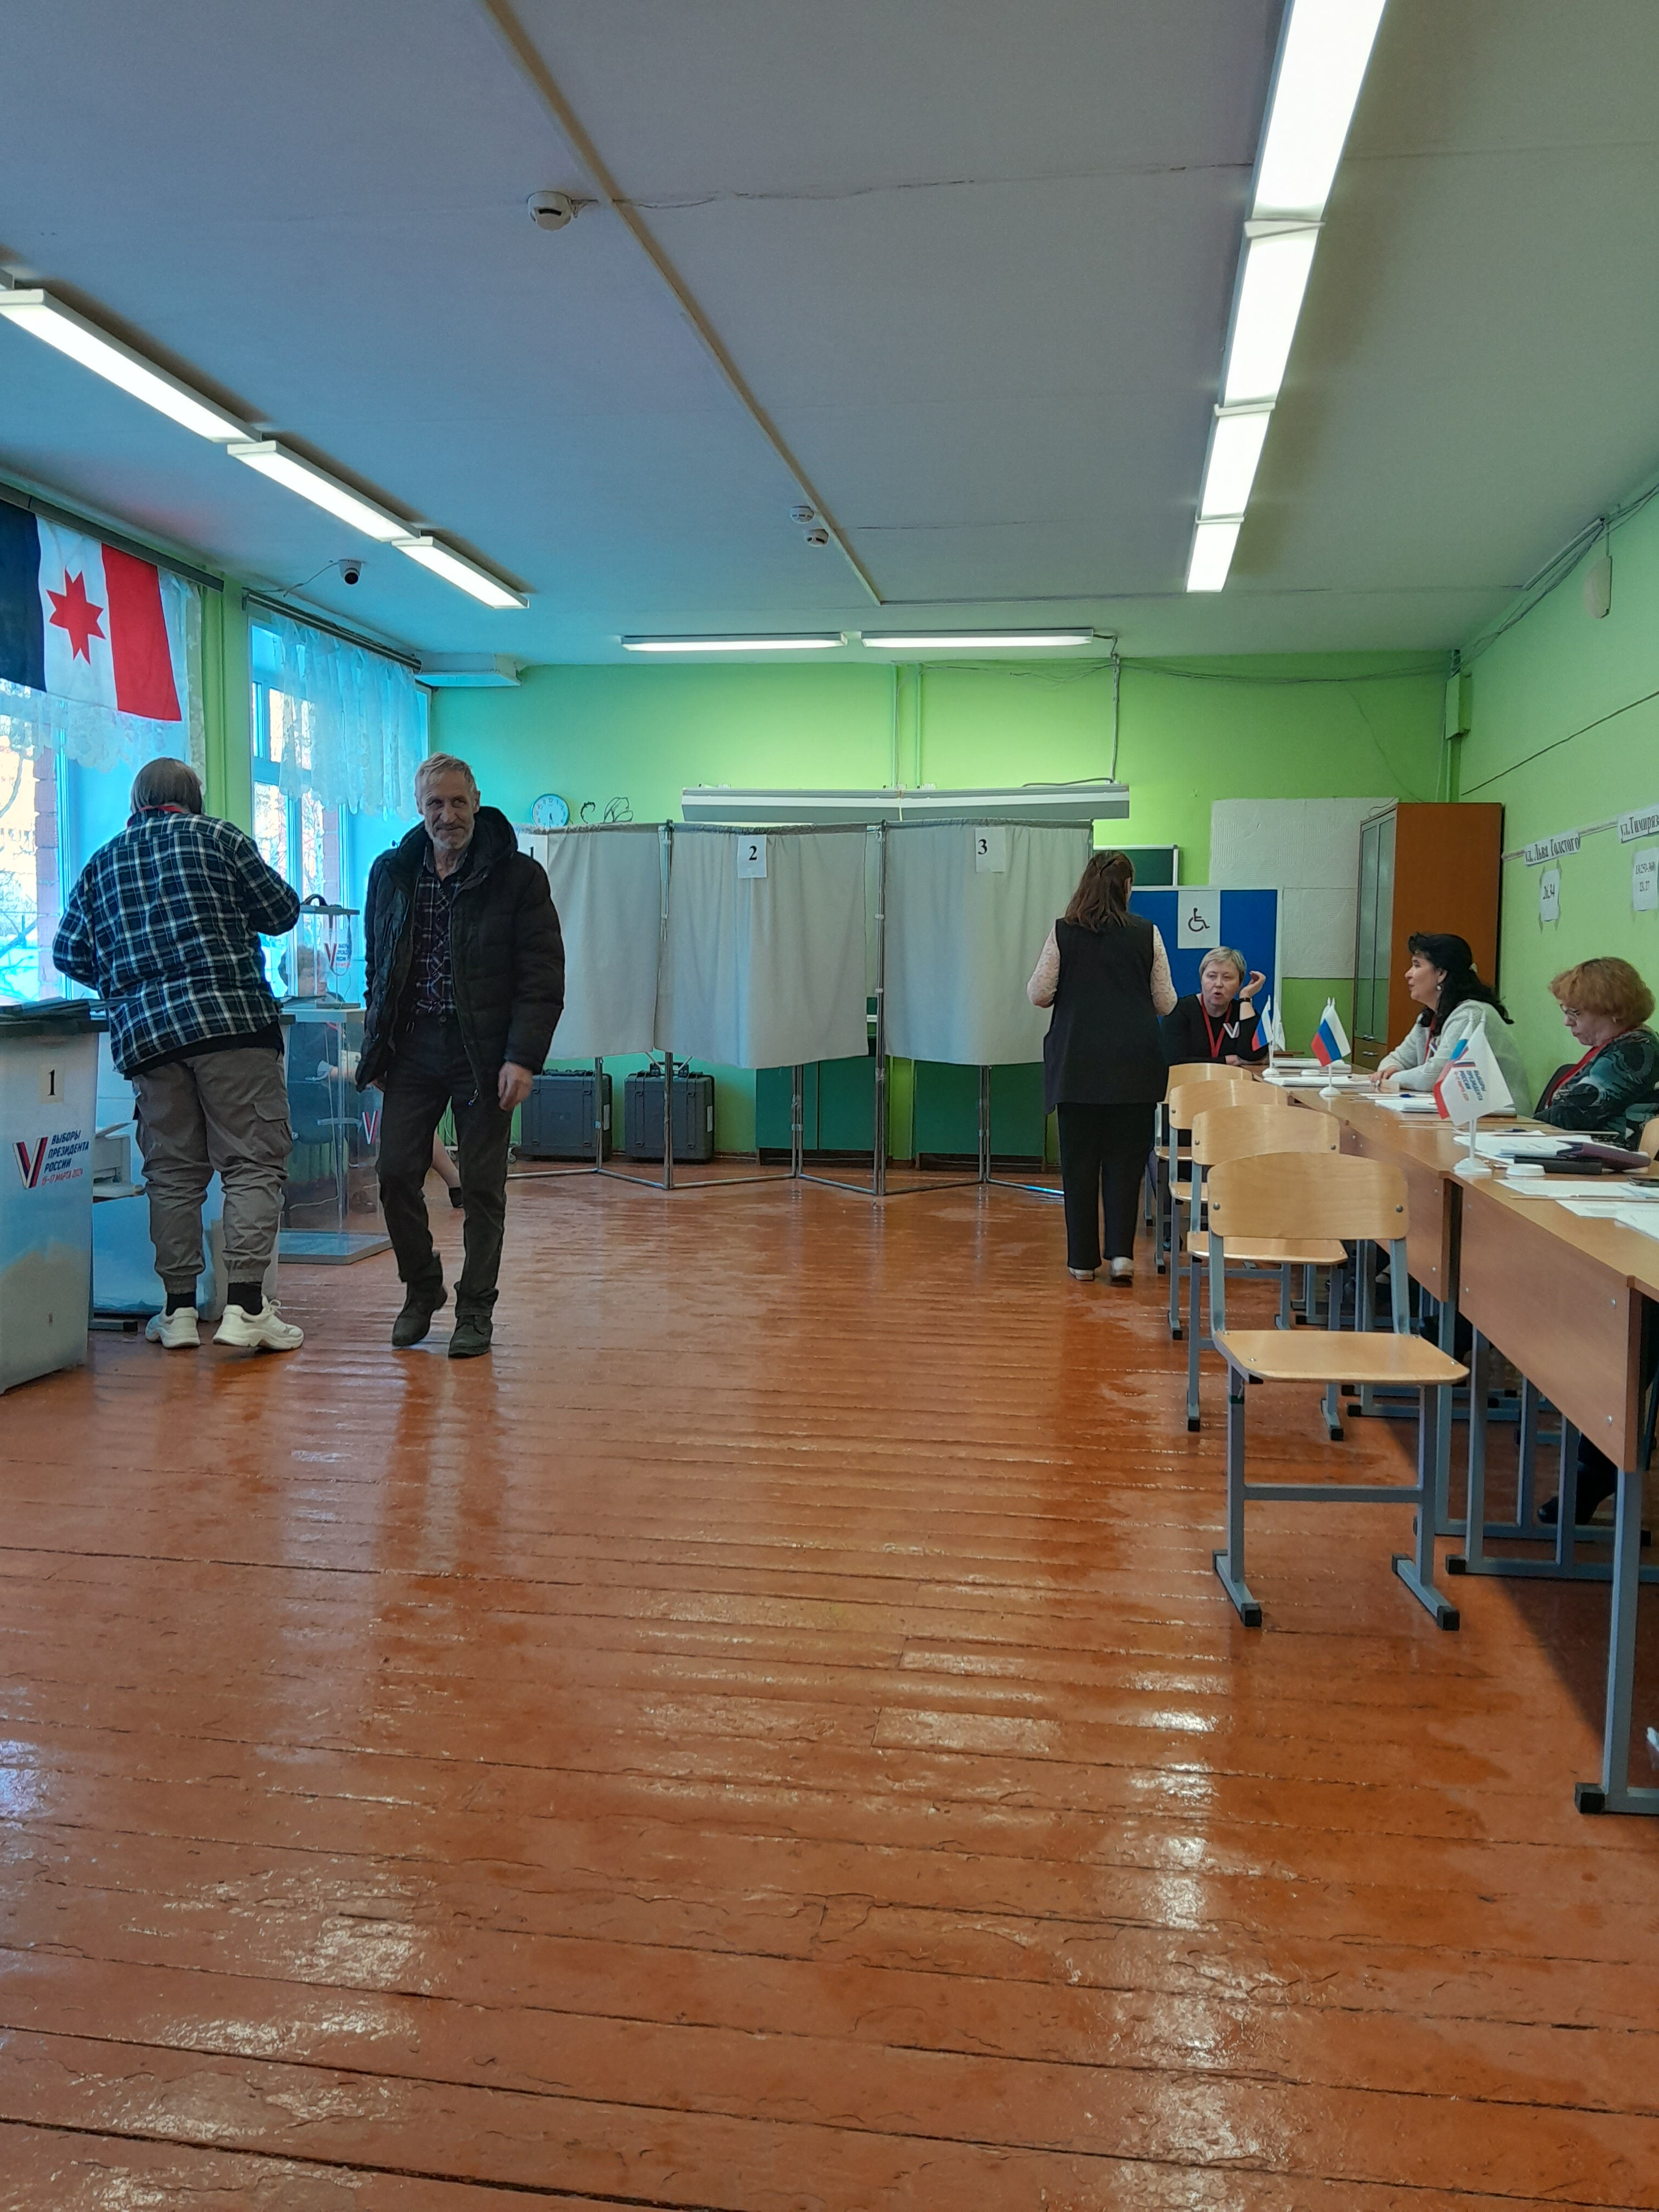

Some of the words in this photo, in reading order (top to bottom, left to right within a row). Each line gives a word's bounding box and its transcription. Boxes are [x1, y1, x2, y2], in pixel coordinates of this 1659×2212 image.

[749, 845, 757, 861] 2
[978, 839, 987, 855] 3
[1550, 838, 1580, 856] Толстого
[47, 1069, 56, 1096] 1
[51, 1130, 81, 1145] ВЫБОРЫ
[48, 1141, 89, 1159] ПРЕЗИДЕНТА
[44, 1158, 72, 1173] РОССИИ
